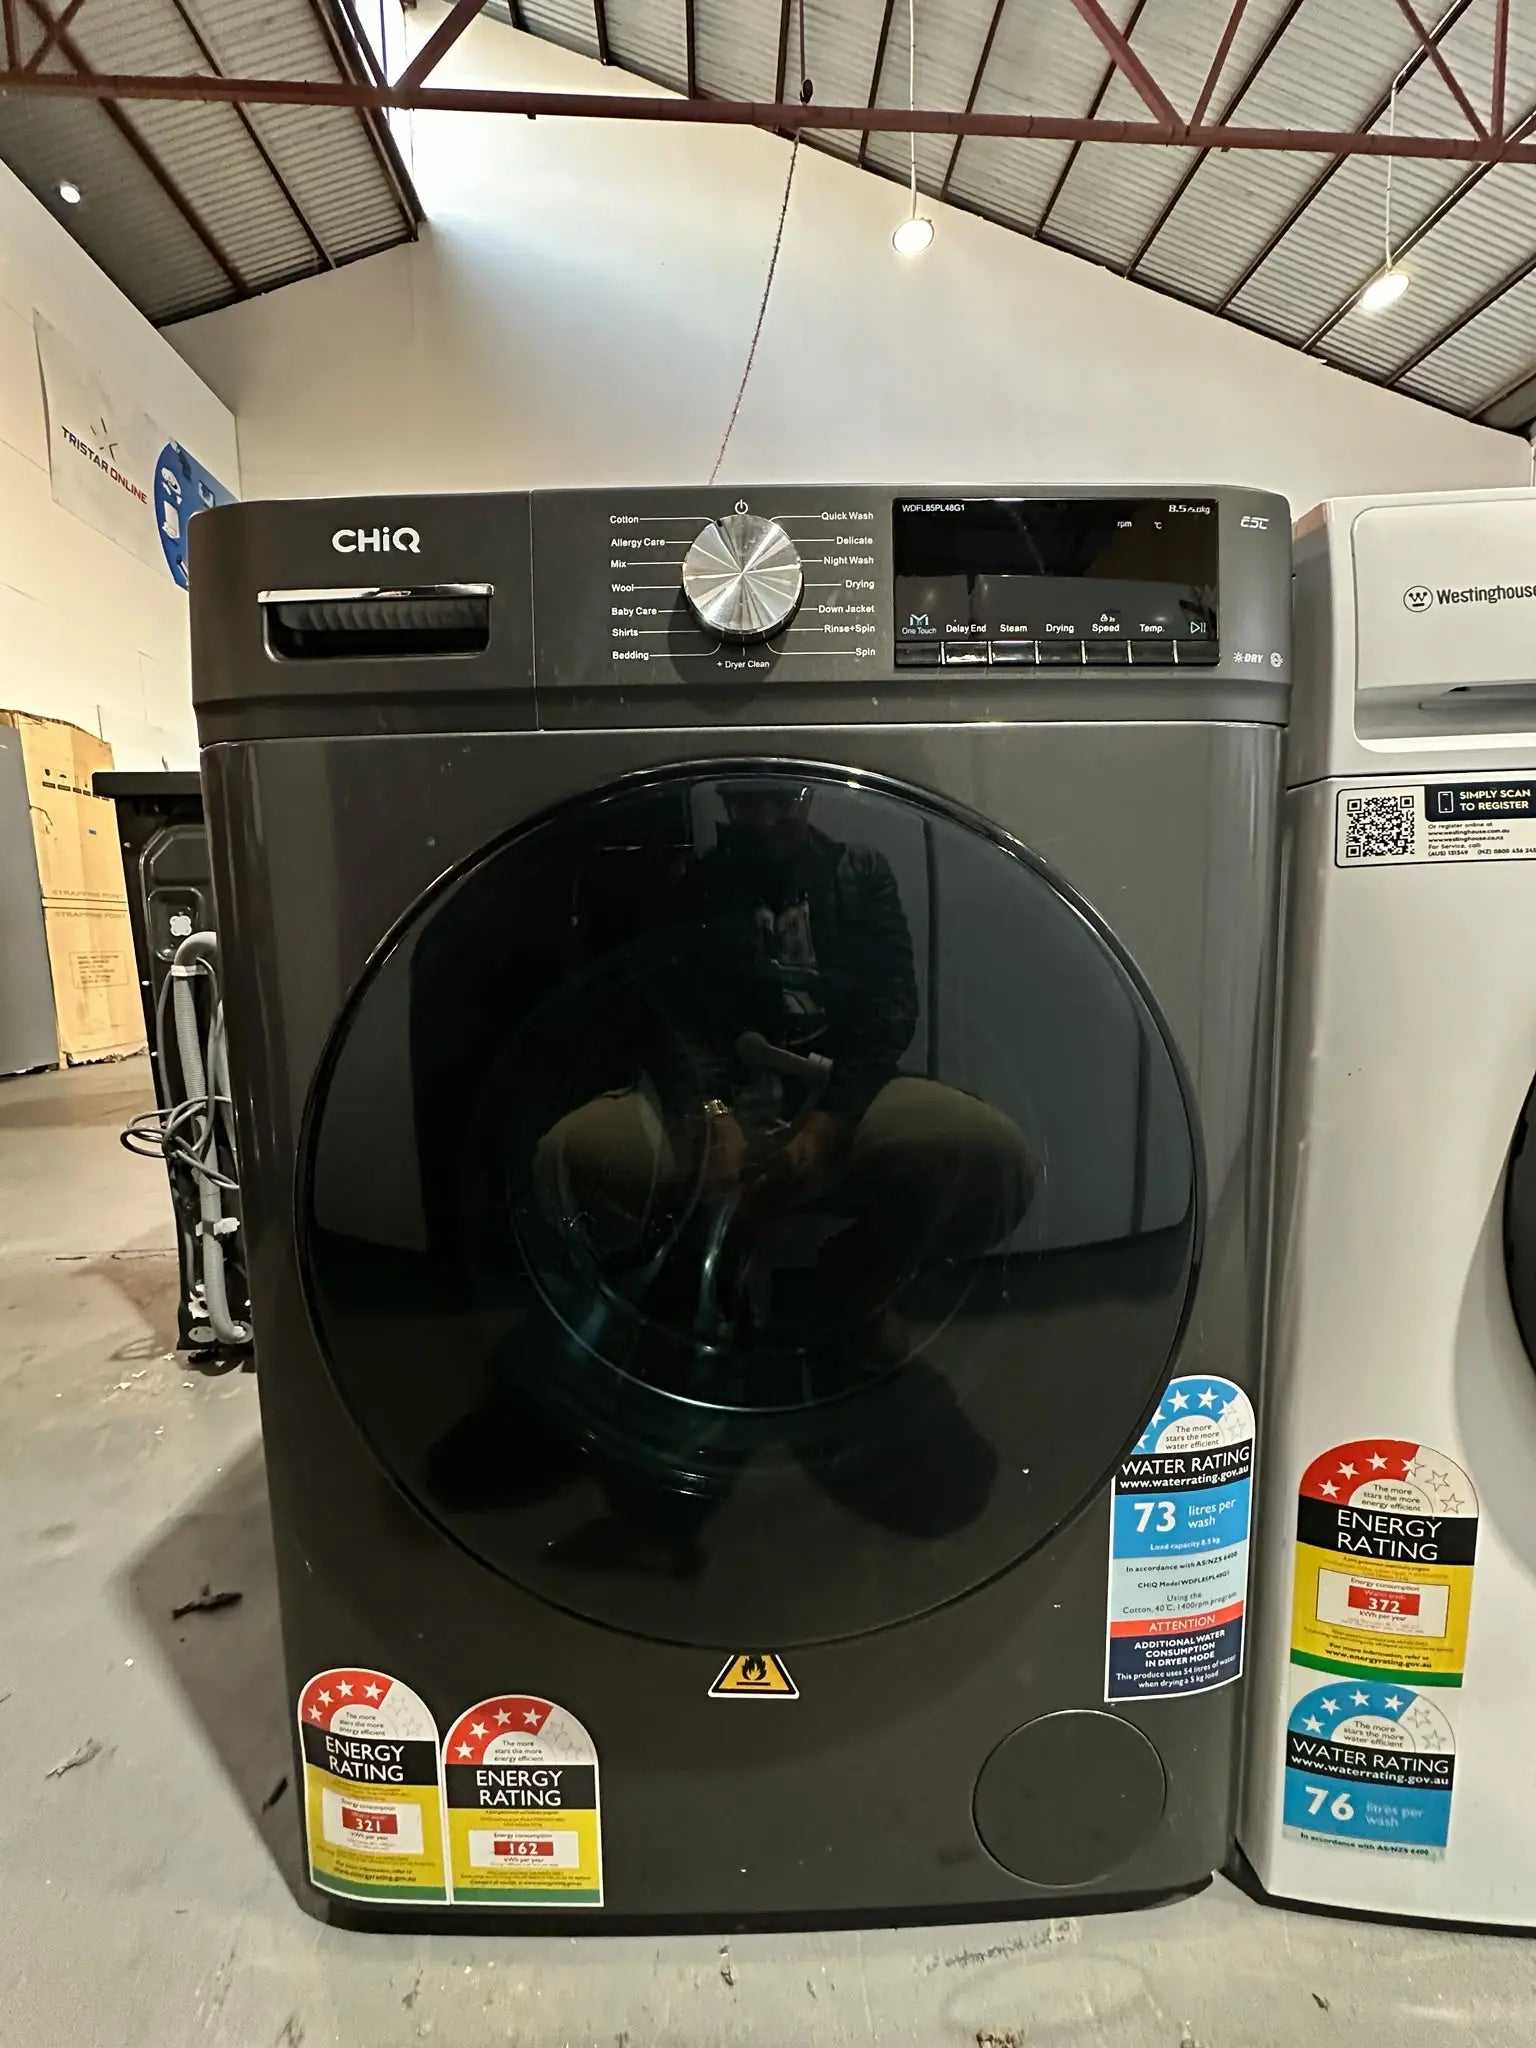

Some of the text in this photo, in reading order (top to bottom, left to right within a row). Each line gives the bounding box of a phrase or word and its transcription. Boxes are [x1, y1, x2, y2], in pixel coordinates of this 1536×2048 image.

[62, 426, 147, 504] TRISTAR ONLINE
[902, 504, 965, 512] WDFL85PL48G1
[822, 512, 847, 520] Quick
[332, 527, 420, 553] CHiQ
[611, 538, 665, 548] Allergy Care
[837, 536, 873, 544] Delicate
[824, 556, 848, 566] Night
[612, 584, 634, 592] Wool
[846, 580, 874, 590] Drying
[611, 607, 657, 617] Baby Care
[845, 605, 874, 613] Jacket
[612, 628, 639, 637] Shirts
[824, 624, 875, 634] Rinse+Spin
[946, 624, 986, 634] Delay End
[1000, 624, 1027, 632] Steam
[1046, 624, 1074, 633] Drying
[1092, 624, 1120, 633] Speed
[1140, 624, 1165, 633] Temp.
[612, 651, 649, 660] Bedding
[855, 648, 876, 656] Spin
[1244, 654, 1263, 664] DRY
[1460, 789, 1531, 799] SIMPLY SCAN
[1460, 801, 1529, 811] TO REGISTER
[1190, 1439, 1219, 1449] efficient
[1122, 1446, 1250, 1476] WATER RATING
[1120, 1465, 1249, 1488] www.waterrating.gov.au
[1188, 1499, 1236, 1516] litres per
[1362, 1500, 1421, 1512] energy efficient
[1134, 1501, 1176, 1533] 73
[1188, 1515, 1215, 1528] wash
[1338, 1509, 1442, 1538] ENERGY
[1170, 1540, 1200, 1550] capacity
[1338, 1532, 1438, 1561] RATING
[1135, 1564, 1177, 1572] accordance
[1350, 1578, 1419, 1592] Energy consumption
[1210, 1591, 1237, 1606] program
[1368, 1597, 1400, 1612] 372
[1149, 1615, 1216, 1632] ATTENTION
[1134, 1629, 1225, 1650] ADDITIONAL WATER
[1146, 1642, 1215, 1658] CONSUMPTION
[1158, 1657, 1188, 1666] DRYER
[1190, 1651, 1215, 1663] MODE
[1325, 1649, 1432, 1668] www.energyrating.gov.au
[1134, 1671, 1164, 1681] produce
[1212, 1660, 1219, 1669] of
[1220, 1654, 1236, 1665] water
[1160, 1678, 1184, 1687] drying
[1196, 1674, 1203, 1682] kg
[1204, 1670, 1219, 1679] load
[339, 1727, 359, 1735] energy
[1354, 1721, 1370, 1730] The
[1344, 1728, 1364, 1737] stars
[1366, 1730, 1380, 1739] the
[325, 1736, 404, 1762] ENERGY
[1370, 1738, 1403, 1748] efficient
[1293, 1738, 1449, 1774] WATER RATING
[329, 1755, 403, 1781] RATING
[1291, 1755, 1449, 1785] www.waterrating.gov.au
[476, 1770, 563, 1787] ENERGY
[480, 1790, 561, 1806] RATING
[1305, 1786, 1354, 1821] 76
[1366, 1801, 1424, 1818] litres per
[356, 1818, 380, 1832] 321
[1366, 1815, 1398, 1827] wash
[1311, 1835, 1355, 1847] accordance
[510, 1843, 538, 1855] 162
